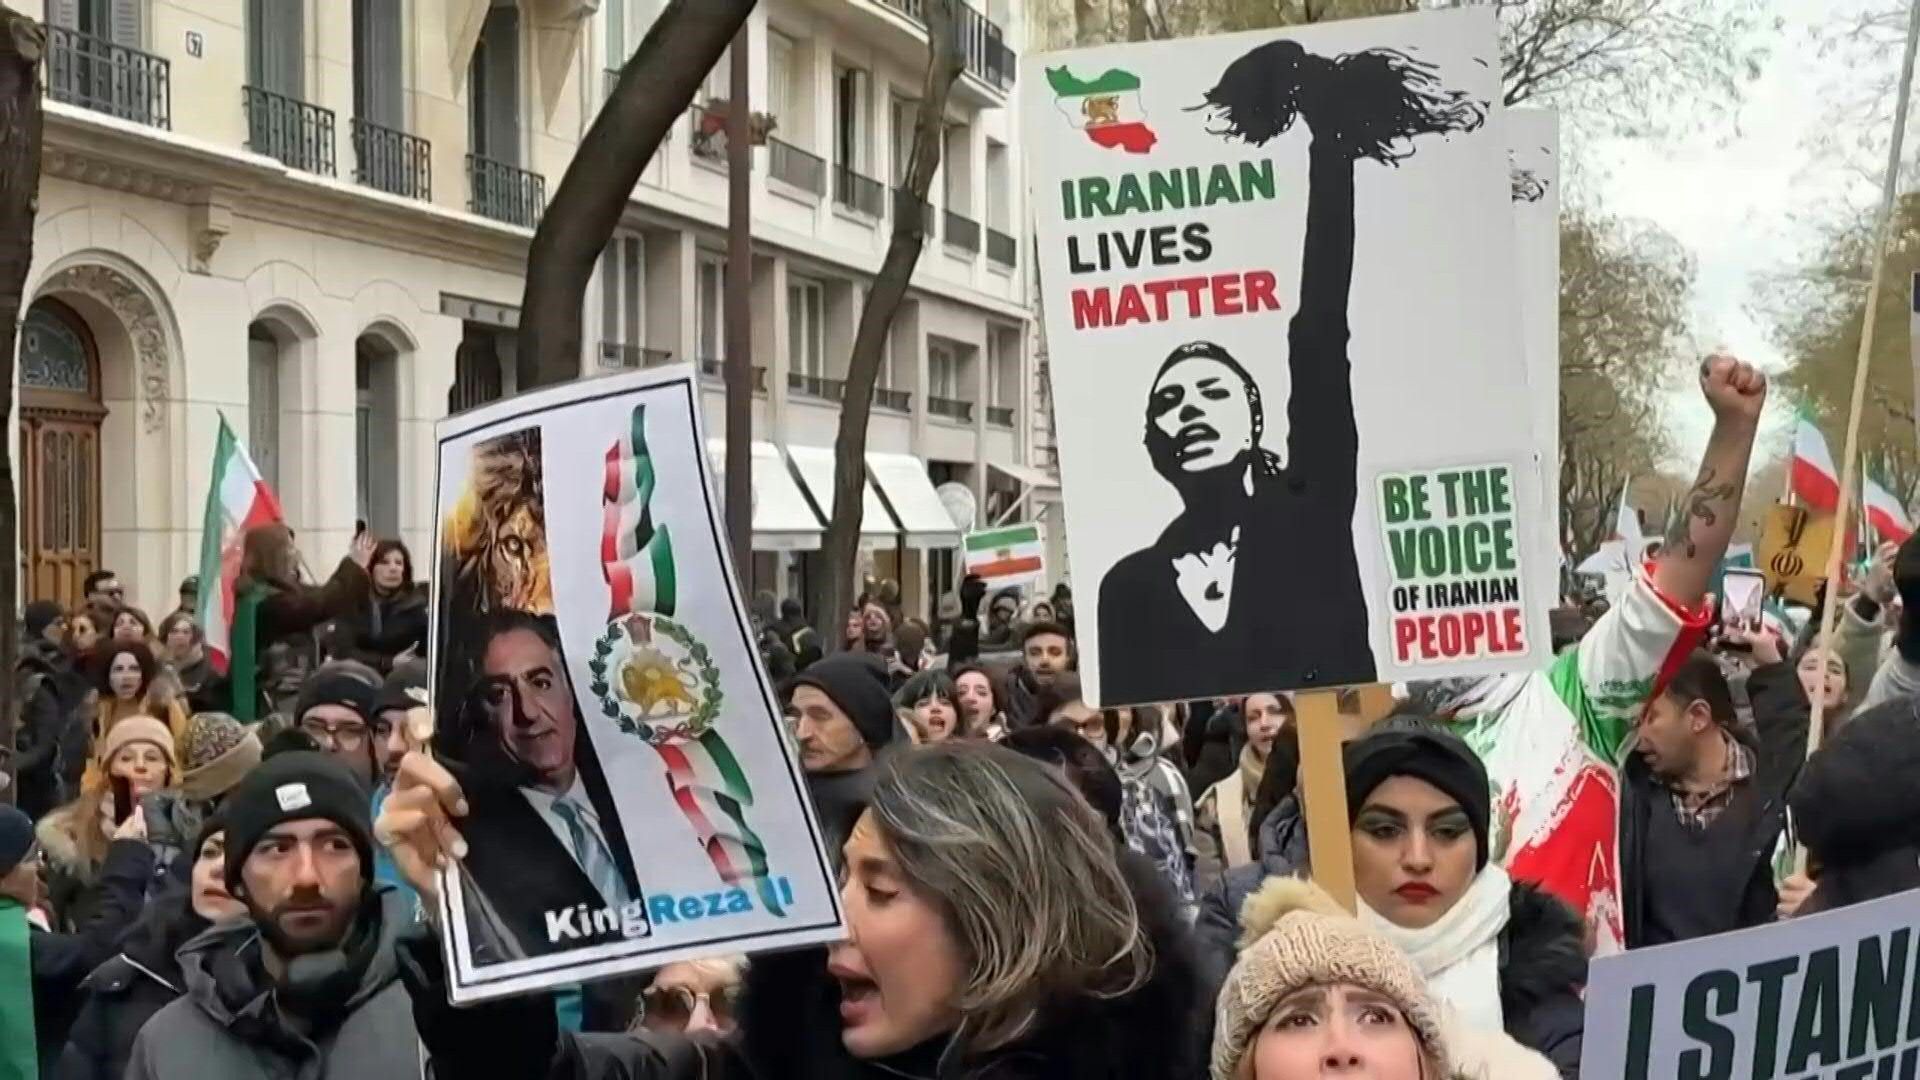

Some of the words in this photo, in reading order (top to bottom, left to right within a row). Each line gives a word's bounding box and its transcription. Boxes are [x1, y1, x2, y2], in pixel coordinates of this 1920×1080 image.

[1061, 159, 1276, 220] IRANIAN
[1067, 222, 1213, 274] LIVES
[1071, 270, 1281, 331] MATTER
[1383, 475, 1432, 524] BE
[1437, 466, 1512, 518] THE
[1387, 518, 1516, 580] VOICE
[1392, 584, 1420, 612] OF
[1426, 576, 1520, 609] IRANIAN
[1395, 608, 1524, 661] PEOPLE
[1624, 983, 1656, 1080] I
[1677, 926, 1920, 1080] STAN
